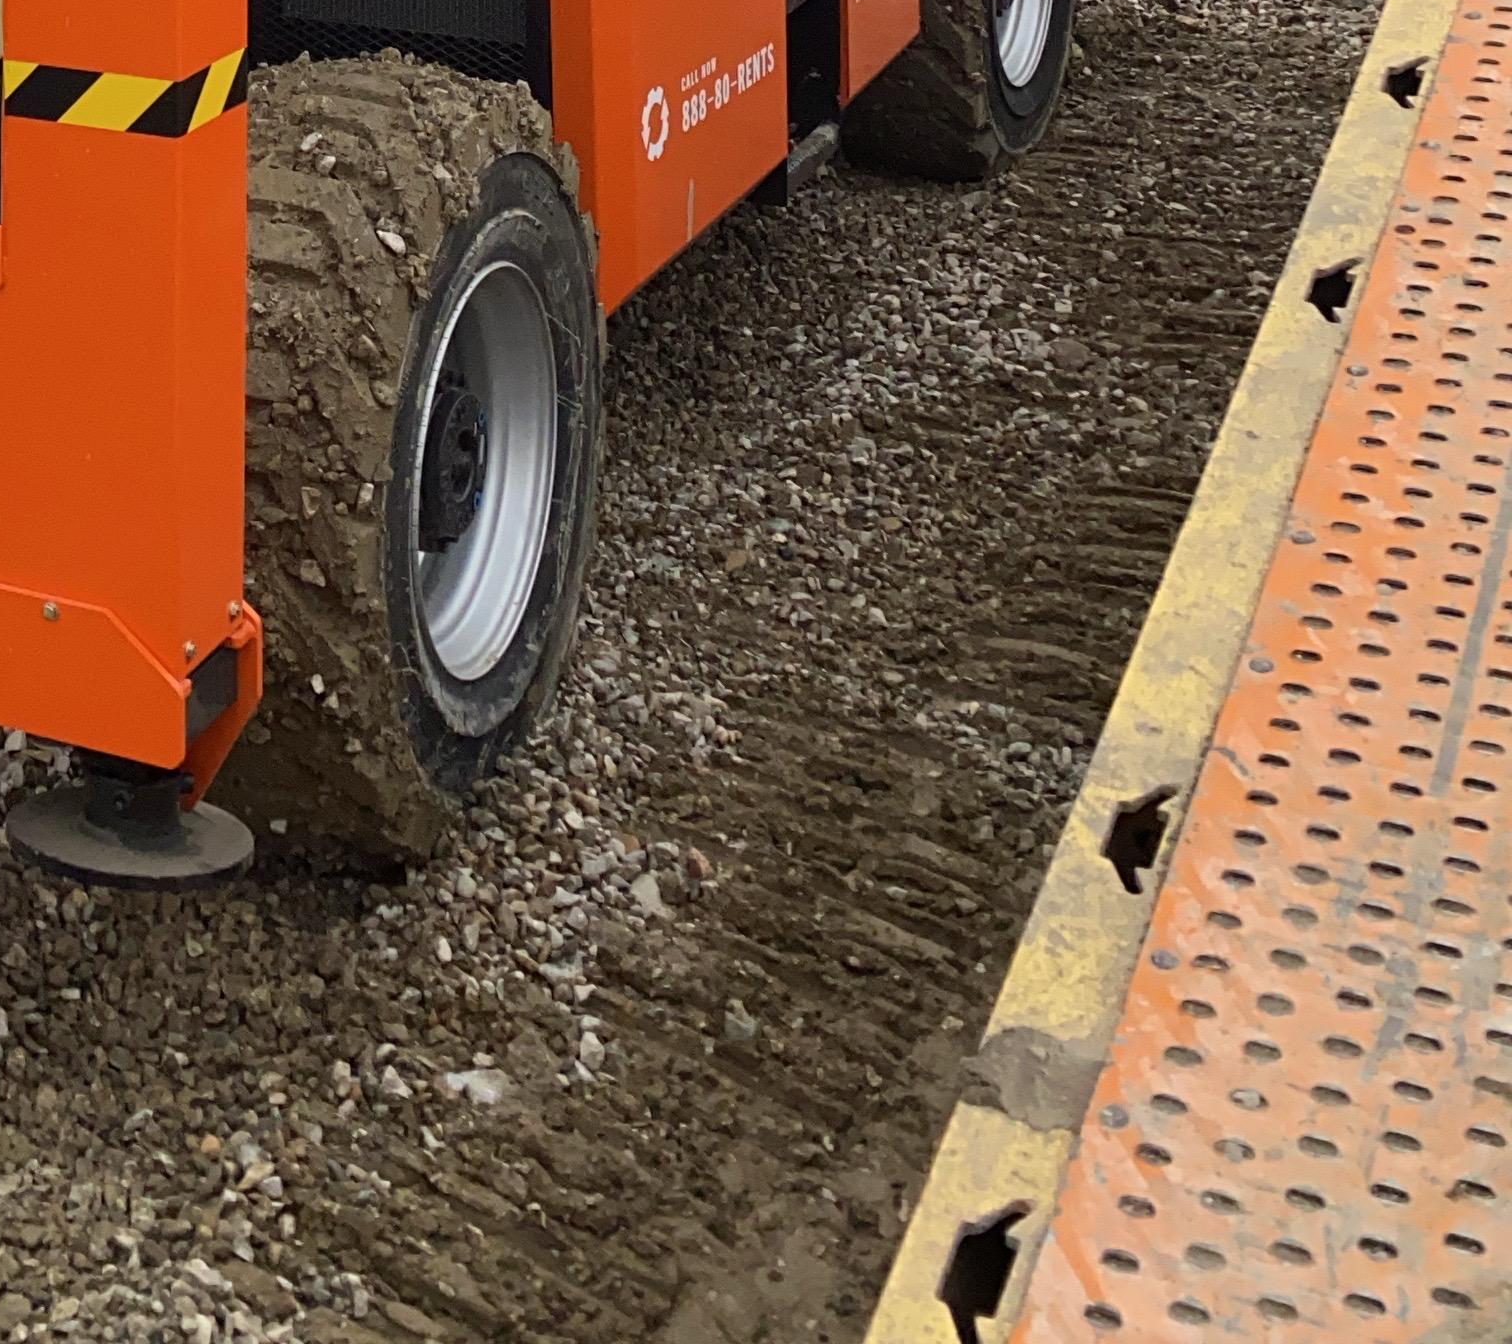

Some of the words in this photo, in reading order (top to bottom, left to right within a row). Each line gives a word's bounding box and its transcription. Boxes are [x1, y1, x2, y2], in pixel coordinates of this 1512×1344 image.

[681, 70, 699, 91] CALL
[701, 57, 717, 79] NOW
[682, 42, 775, 132] 888-80-RENTS
